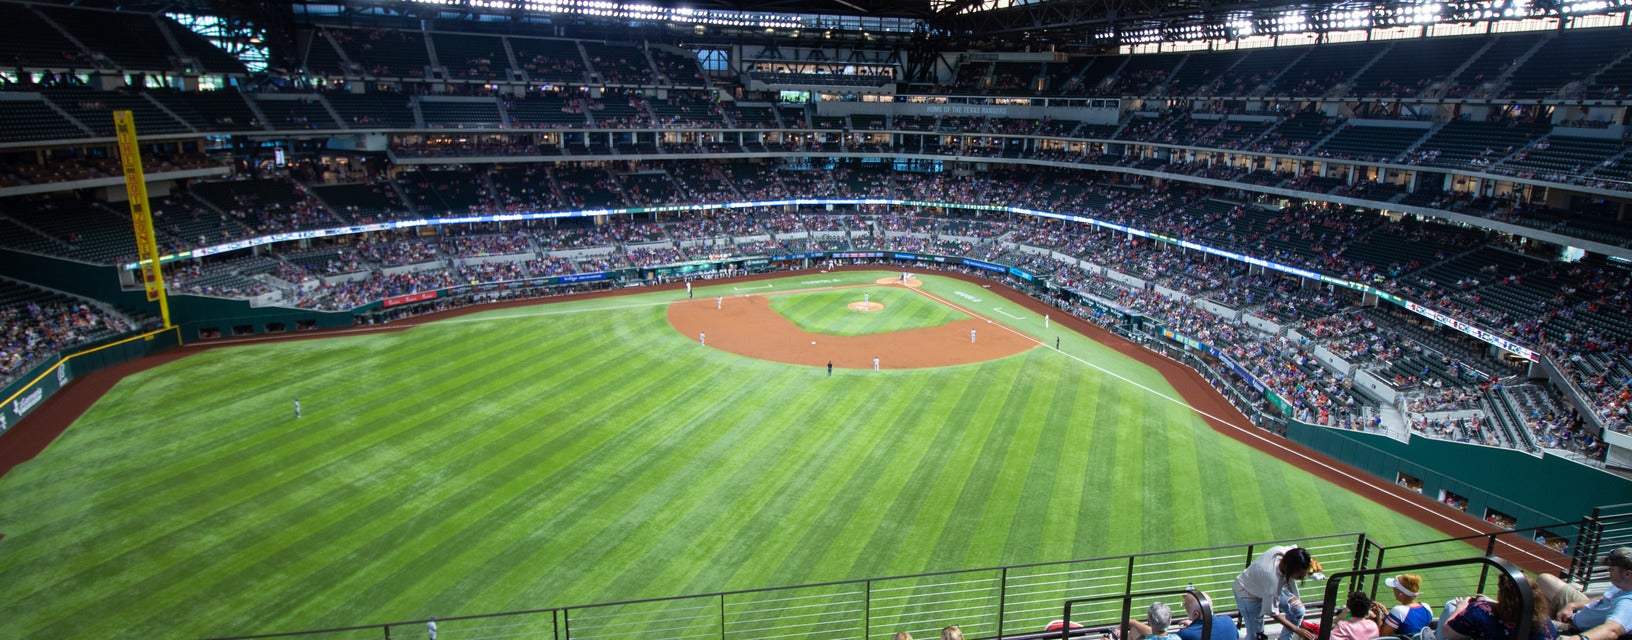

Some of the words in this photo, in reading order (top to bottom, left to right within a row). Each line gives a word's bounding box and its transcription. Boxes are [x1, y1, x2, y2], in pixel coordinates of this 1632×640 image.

[952, 106, 962, 114] THE
[963, 106, 981, 114] TEXAS
[982, 107, 1007, 115] RANGERS
[121, 133, 131, 163] THE
[128, 173, 140, 203] HOT
[135, 211, 150, 254] ZONE
